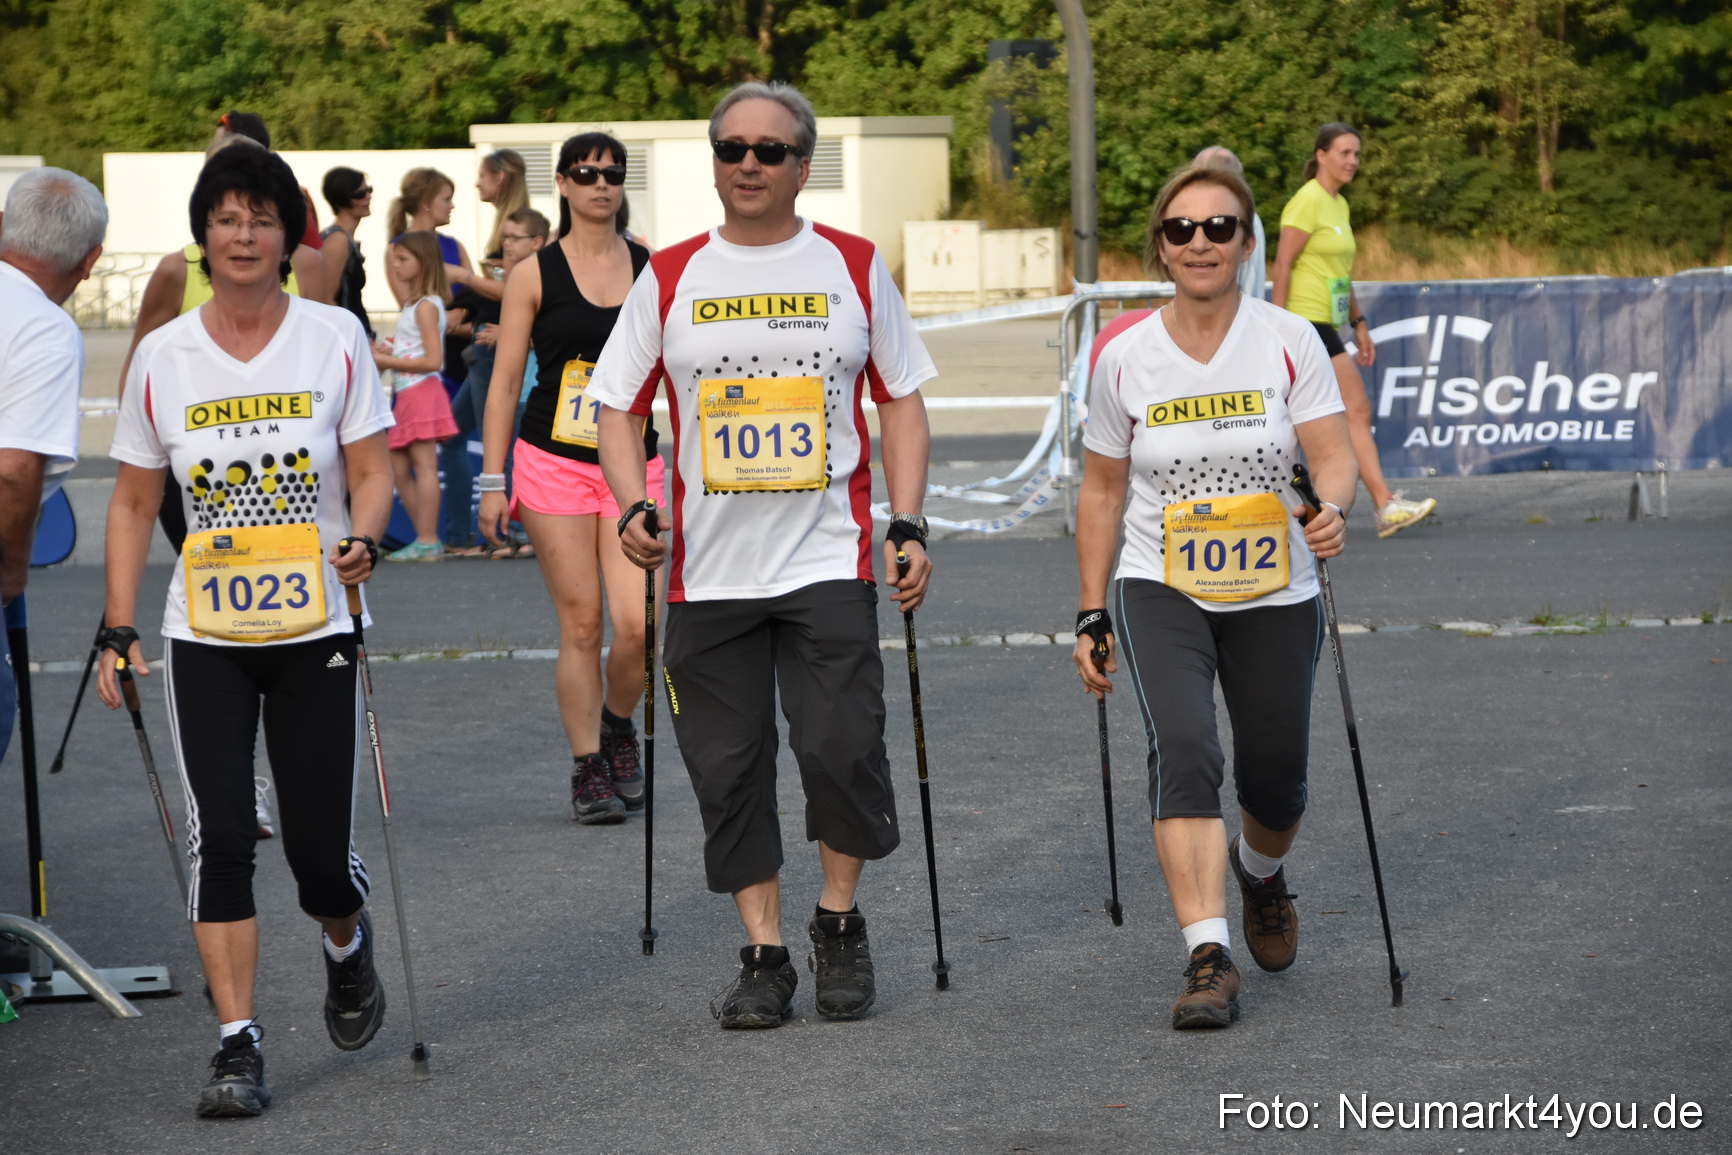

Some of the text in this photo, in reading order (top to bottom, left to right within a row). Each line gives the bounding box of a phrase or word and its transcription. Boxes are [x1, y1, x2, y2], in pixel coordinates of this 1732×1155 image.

[699, 296, 817, 320] ONLINE
[767, 319, 829, 332] Germany
[1378, 361, 1659, 418] Fischer
[717, 396, 760, 406] firmenlauf
[1152, 394, 1255, 423] ONLINE
[191, 396, 302, 426] ONLINE
[569, 394, 601, 425] 11
[706, 409, 740, 419] walken
[1212, 417, 1267, 430] Germany
[217, 423, 280, 440] TEAM
[1403, 420, 1636, 448] AUTOMOBILE
[714, 422, 813, 459] 1013
[735, 465, 792, 474] Thomas Batsch
[1184, 513, 1229, 521] firmenlauf
[1172, 525, 1208, 534] walken
[203, 546, 252, 557] firmenlauf
[1179, 536, 1278, 573] 1012
[191, 560, 231, 571] walken
[1234, 577, 1260, 586] Batsch
[201, 572, 310, 612] 1023
[231, 619, 282, 627] Cornelia Loy
[662, 665, 680, 715] SALOMON
